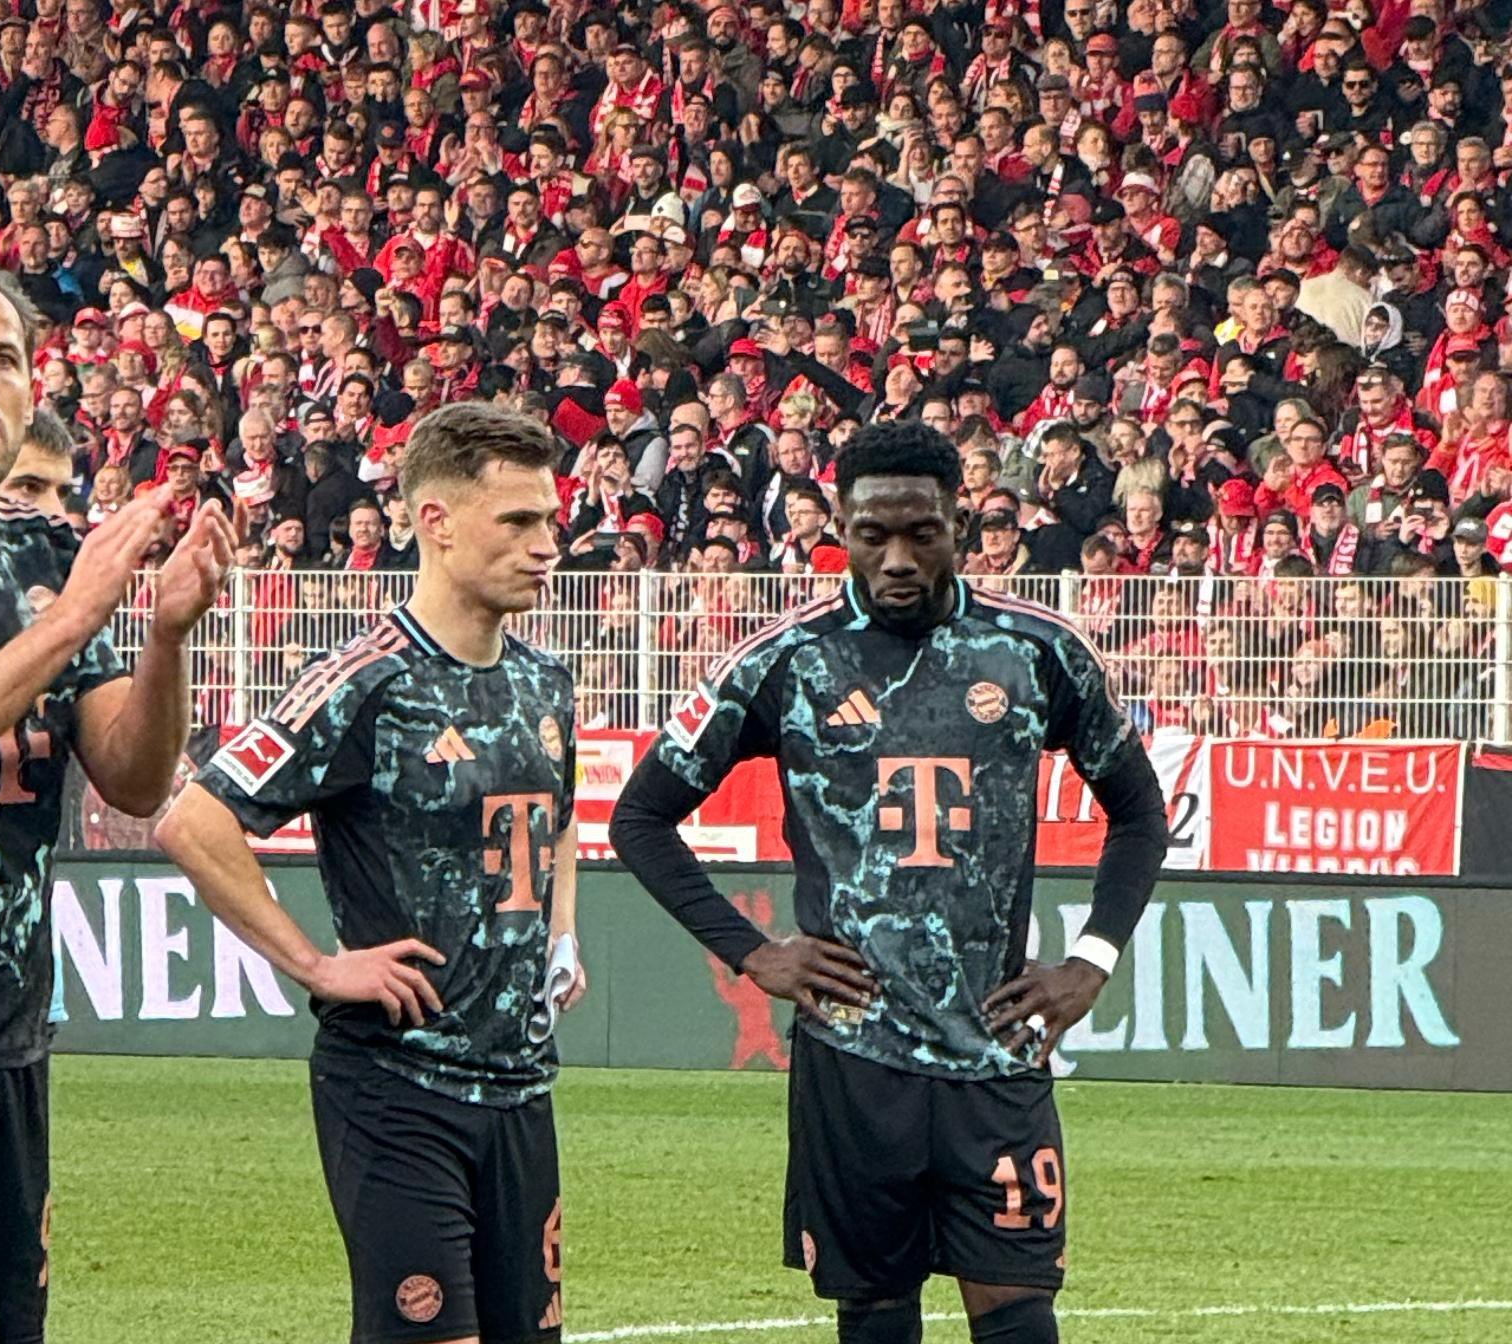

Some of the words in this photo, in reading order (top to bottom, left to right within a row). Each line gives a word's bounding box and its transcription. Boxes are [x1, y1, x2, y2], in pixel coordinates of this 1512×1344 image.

[1225, 746, 1446, 794] U.N.V.E.U.
[482, 792, 554, 914] T
[877, 757, 971, 869] T
[1263, 801, 1408, 851] LEGION
[991, 1146, 1064, 1230] 19
